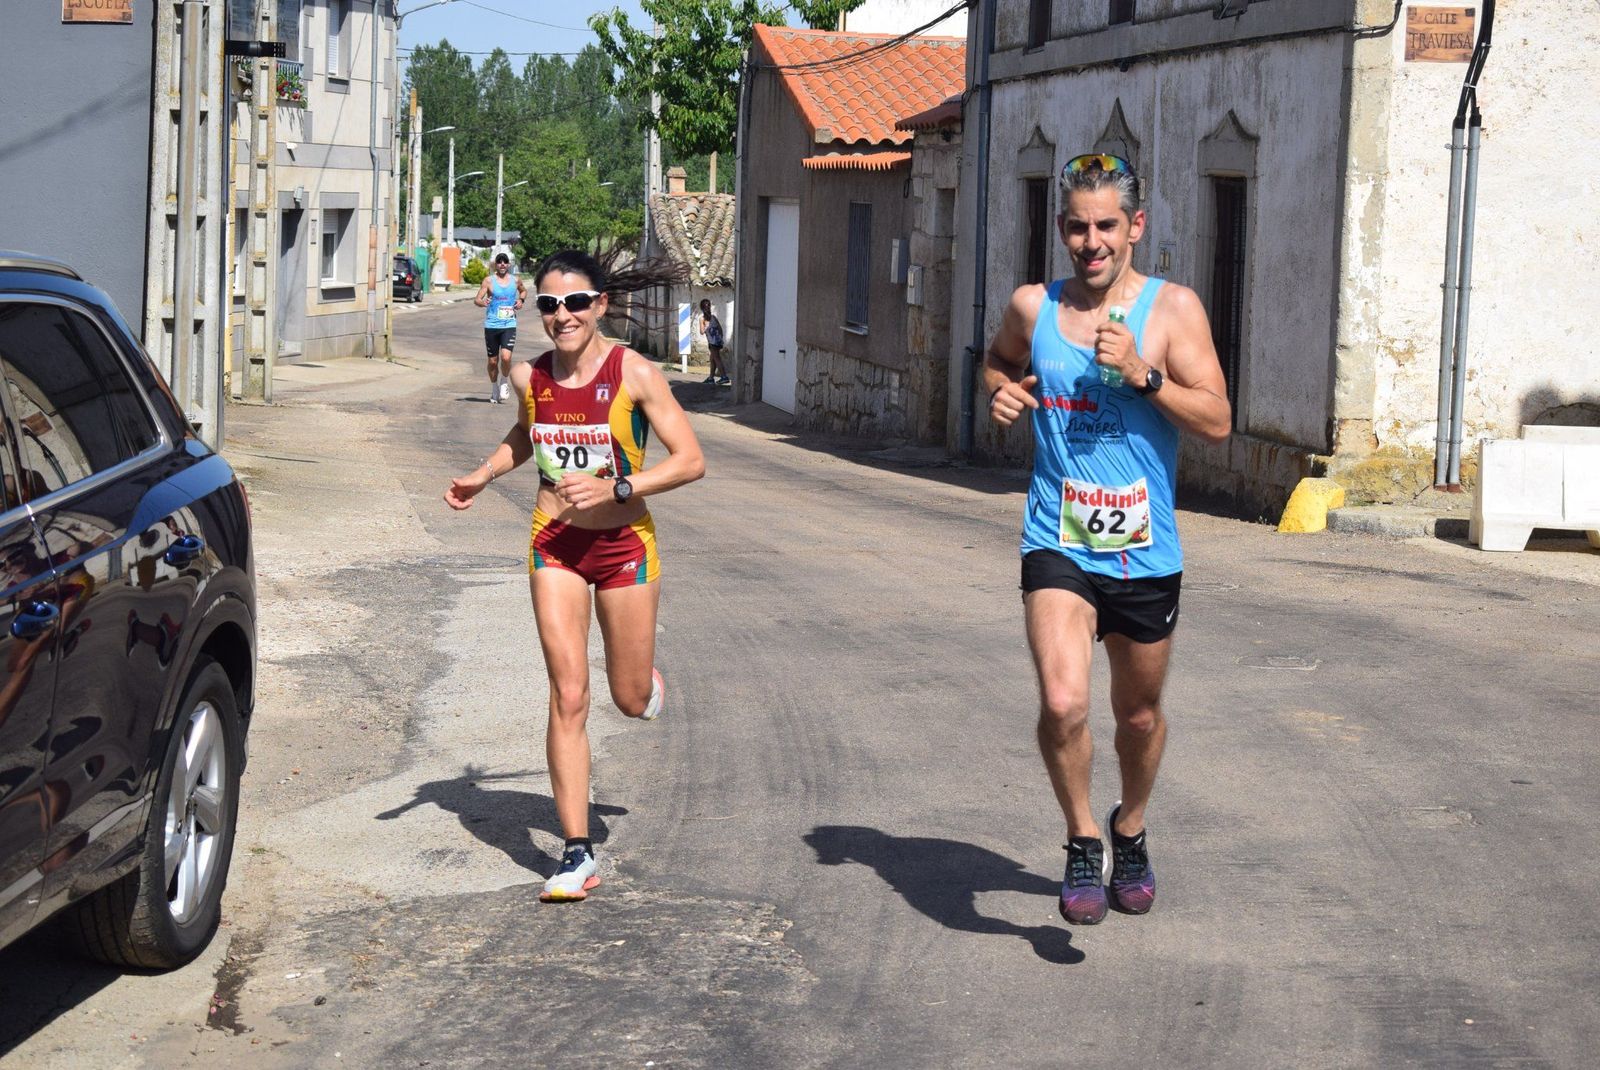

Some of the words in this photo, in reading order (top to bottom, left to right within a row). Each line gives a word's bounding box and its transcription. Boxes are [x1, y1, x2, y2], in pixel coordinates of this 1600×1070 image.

[1425, 13, 1457, 24] CALLE
[1409, 32, 1473, 49] TRAVIESA
[555, 413, 586, 423] VINO
[1065, 417, 1117, 434] FLOWERS
[531, 427, 610, 446] bedunia
[555, 446, 588, 469] 90
[1064, 483, 1147, 508] bedunia
[1087, 509, 1126, 534] 62
